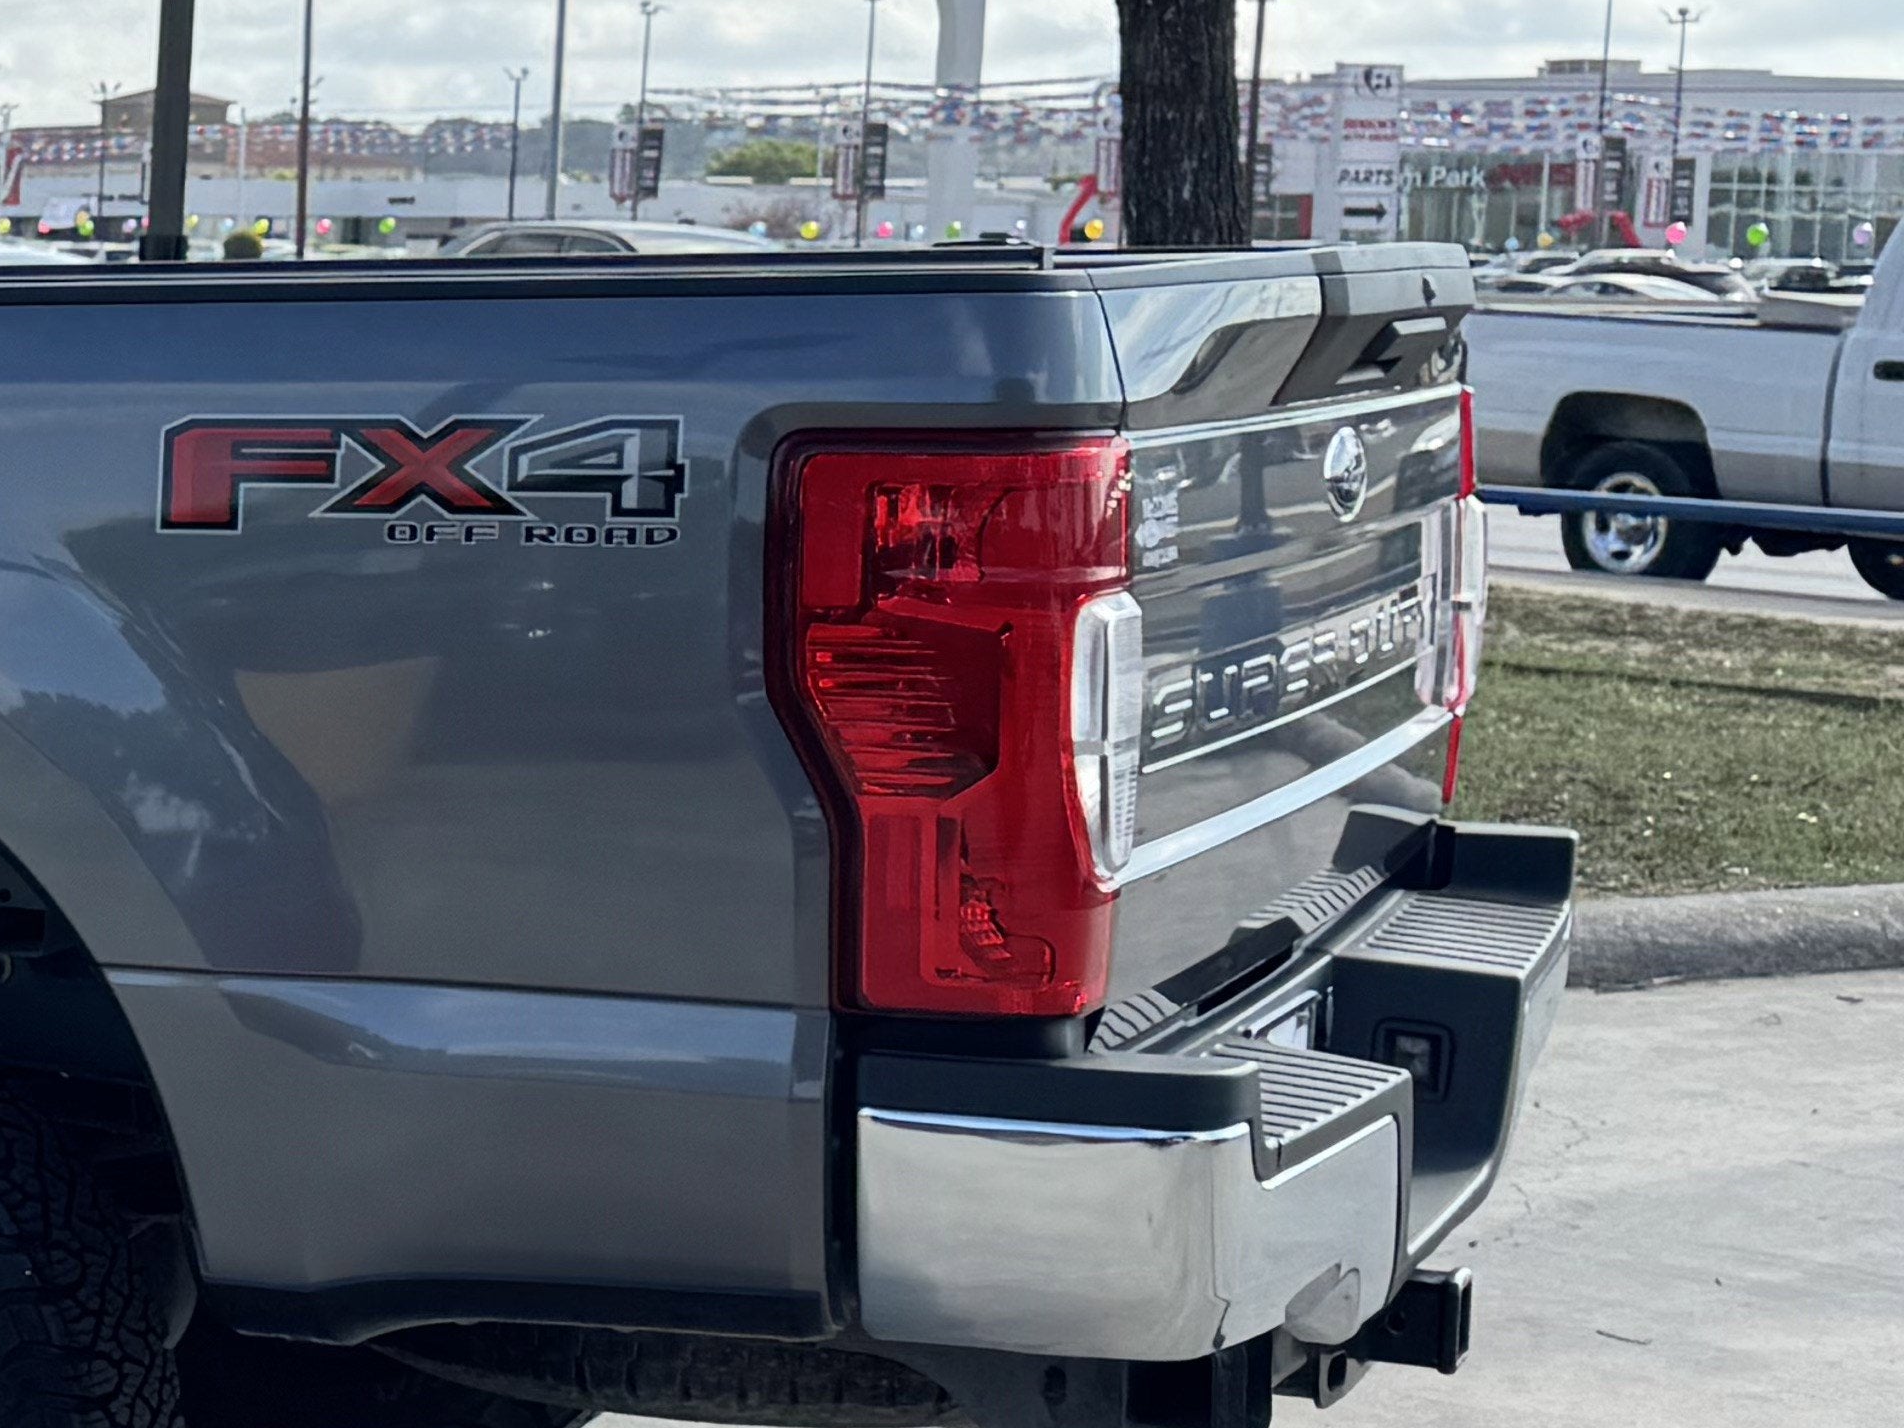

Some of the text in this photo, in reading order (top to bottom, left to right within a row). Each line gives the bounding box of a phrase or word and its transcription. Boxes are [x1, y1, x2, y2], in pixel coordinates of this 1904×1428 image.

[157, 414, 689, 534] FX4
[385, 520, 681, 548] OFF ROAD
